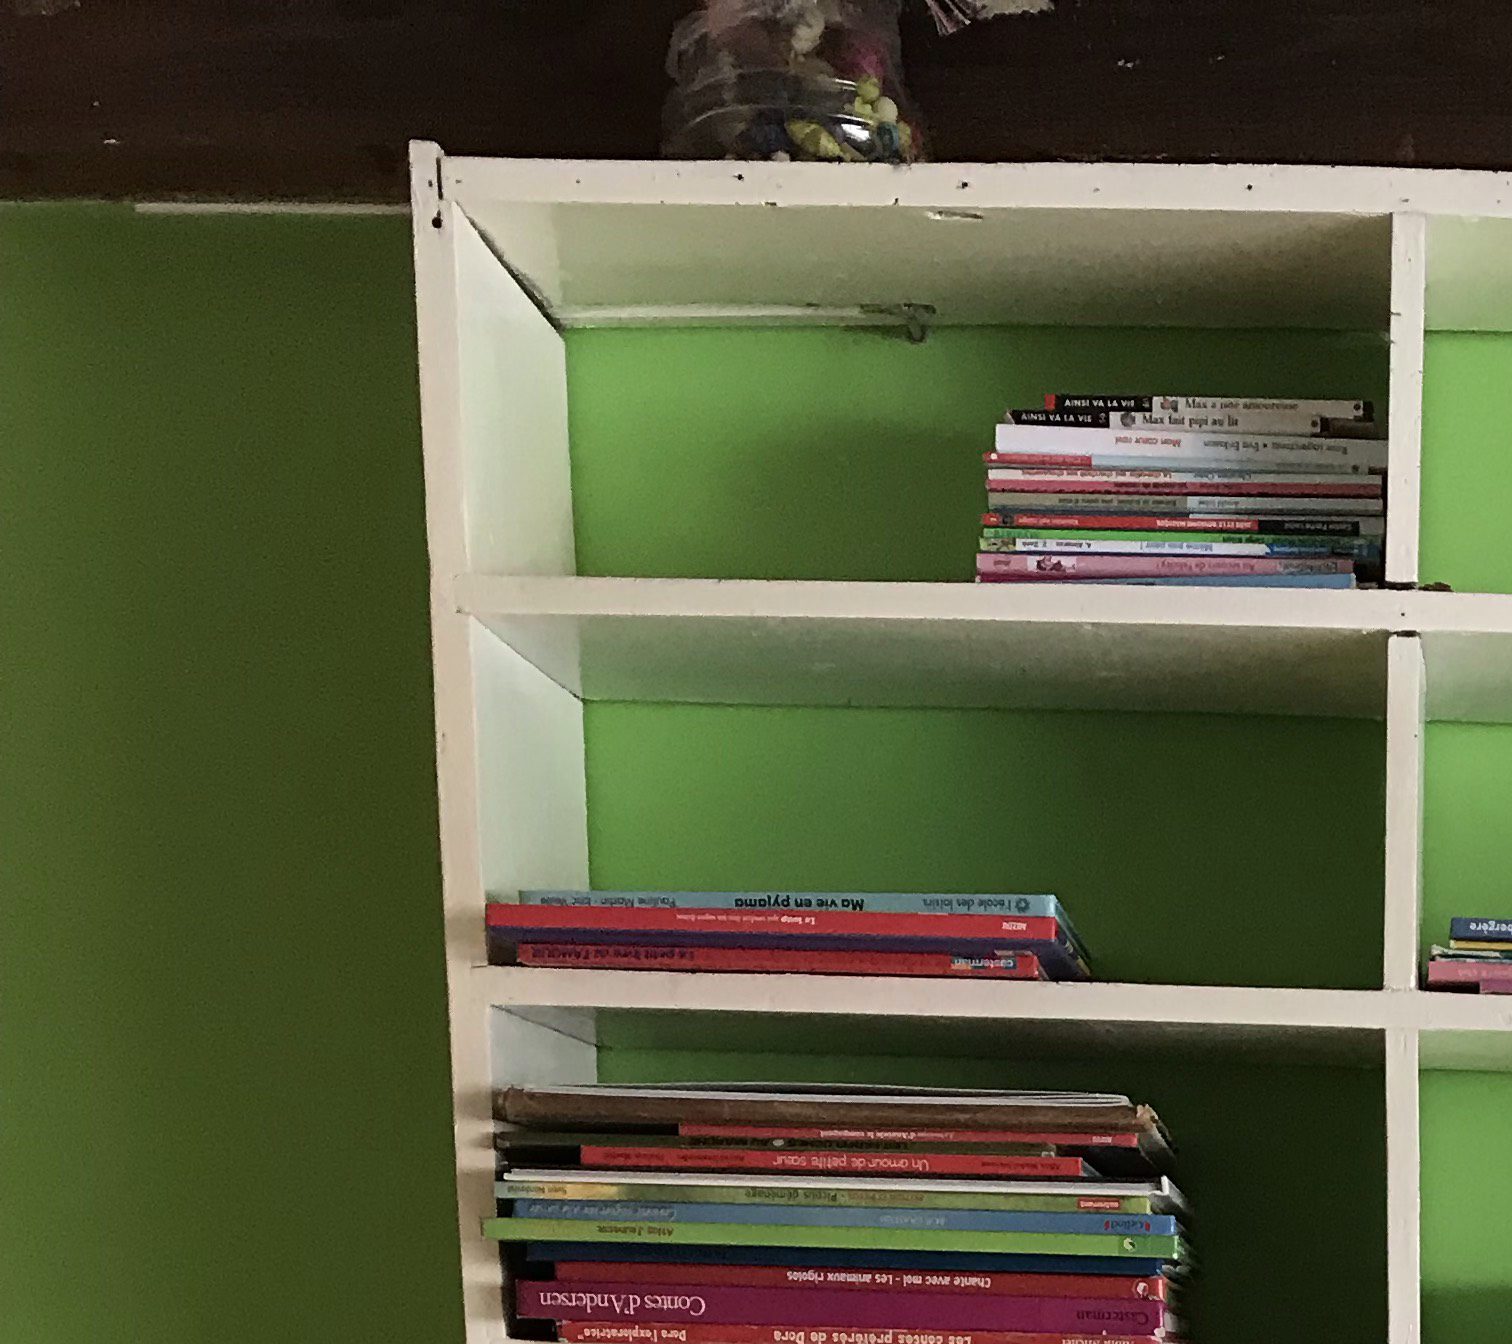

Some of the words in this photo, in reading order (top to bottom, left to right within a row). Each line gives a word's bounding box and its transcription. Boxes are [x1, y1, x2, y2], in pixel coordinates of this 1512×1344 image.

[1064, 399, 1090, 408] AINSI
[1091, 399, 1105, 408] VA
[1107, 399, 1119, 408] LA
[1020, 412, 1047, 422] AINSI
[1048, 413, 1062, 423] VA
[1064, 414, 1075, 423] LA
[1142, 414, 1164, 425] Max
[734, 894, 791, 909] pyjama
[794, 897, 813, 909] en
[816, 897, 839, 910] vie
[842, 898, 864, 911] Ma
[921, 898, 954, 911] loisirs
[956, 898, 975, 911] des
[953, 957, 1014, 969] casterman
[809, 1154, 847, 1169] petite
[850, 1157, 866, 1168] de
[867, 1158, 909, 1169] amour
[911, 1159, 930, 1171] Un
[786, 1269, 825, 1285] rigolos
[826, 1273, 872, 1286] animaux
[874, 1274, 893, 1286] Les
[903, 1274, 923, 1288] moi
[925, 1275, 951, 1288] avec
[953, 1276, 992, 1289] Chante
[539, 1291, 641, 1315] d'Andersen
[644, 1294, 707, 1317] Contes
[1075, 1311, 1150, 1328] Casterman
[660, 1329, 688, 1343] Dora
